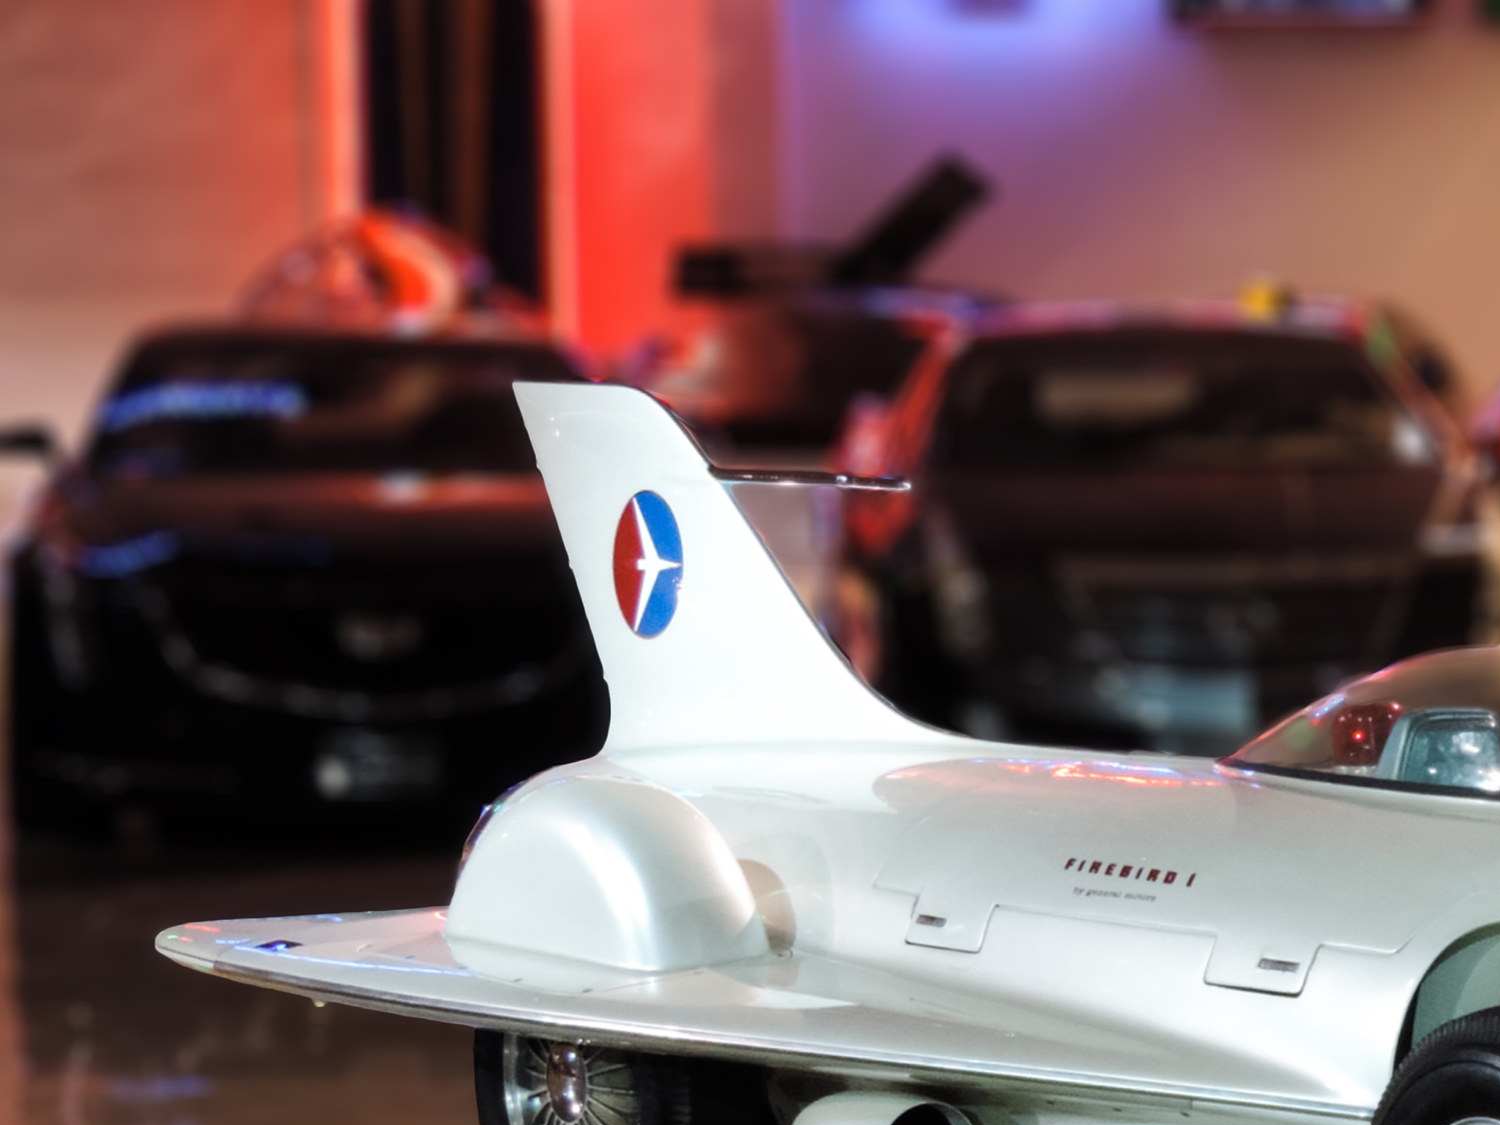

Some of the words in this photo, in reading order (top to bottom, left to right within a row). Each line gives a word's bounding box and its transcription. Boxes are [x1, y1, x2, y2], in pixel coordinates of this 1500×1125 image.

[1064, 857, 1178, 885] FIREBIRD
[1073, 886, 1085, 896] by
[1085, 888, 1122, 899] general
[1123, 892, 1157, 902] motors
